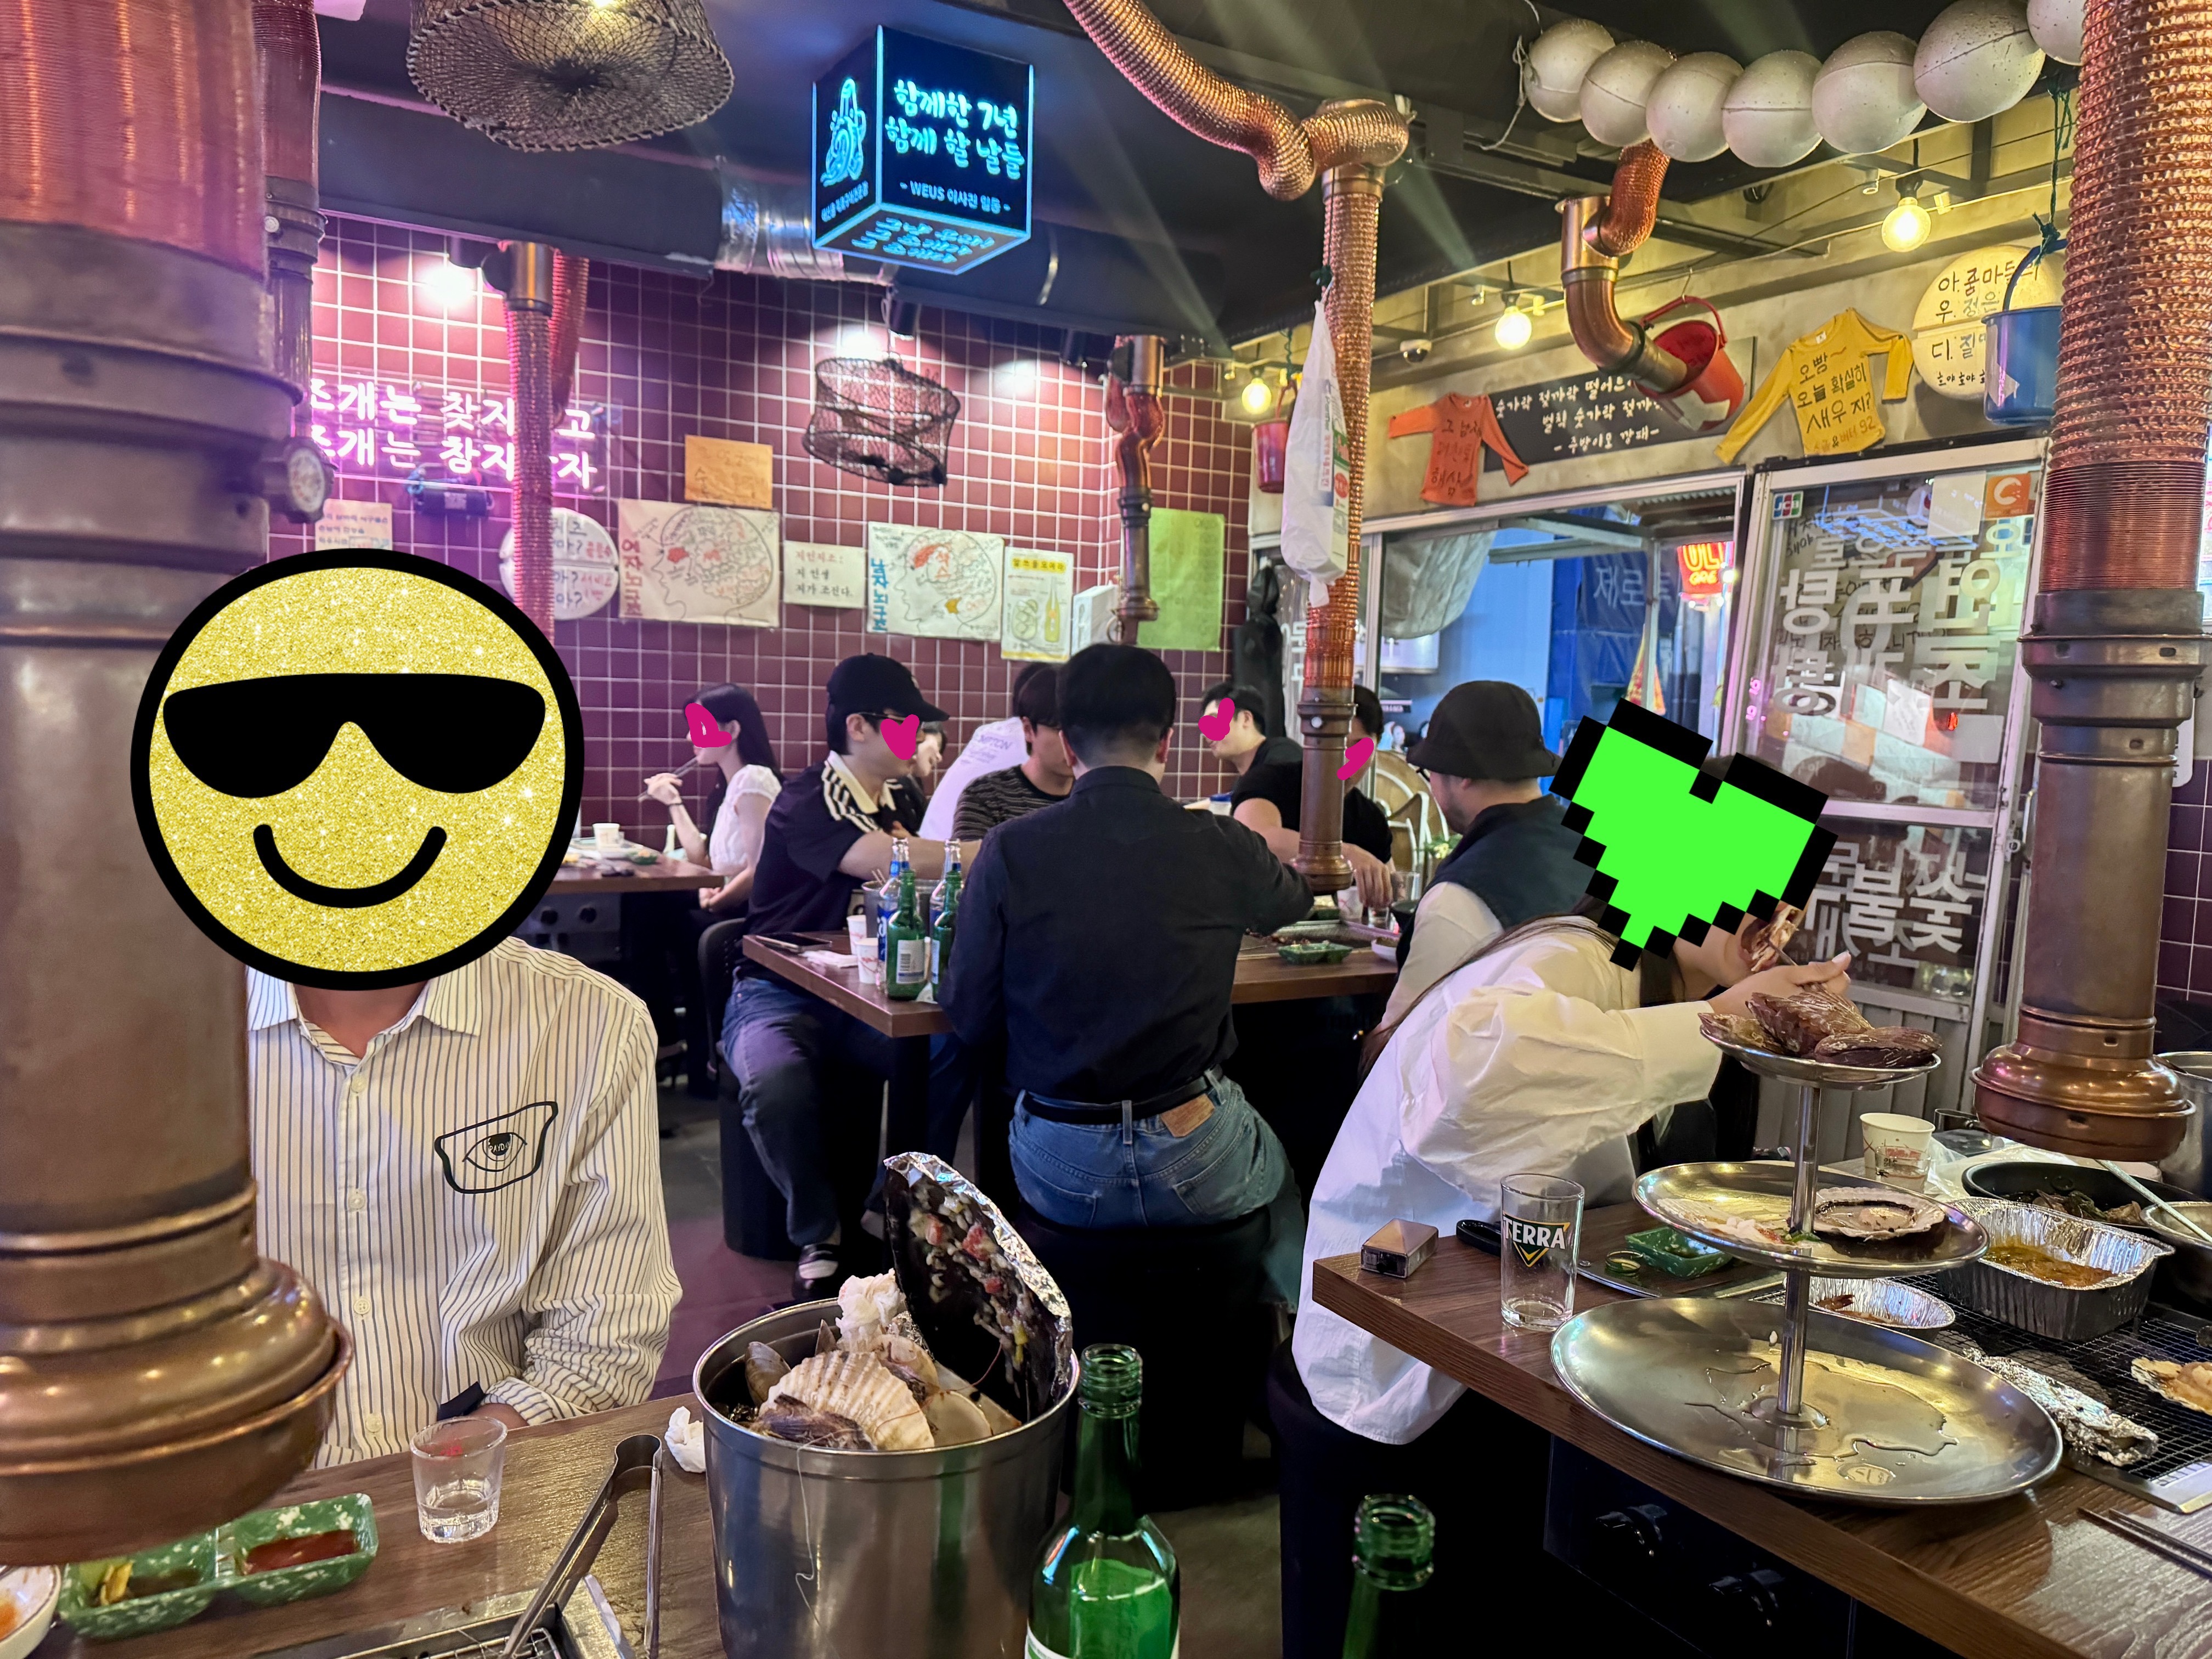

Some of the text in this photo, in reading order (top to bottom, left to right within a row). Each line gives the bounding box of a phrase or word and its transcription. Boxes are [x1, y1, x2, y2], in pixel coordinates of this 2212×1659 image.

[894, 79, 1018, 139] 함께한 7년
[885, 116, 1025, 180] 함께 할 날들
[910, 180, 945, 201] WEUS
[1543, 410, 1567, 434] 벌칙
[1503, 1215, 1566, 1250] TERRA
